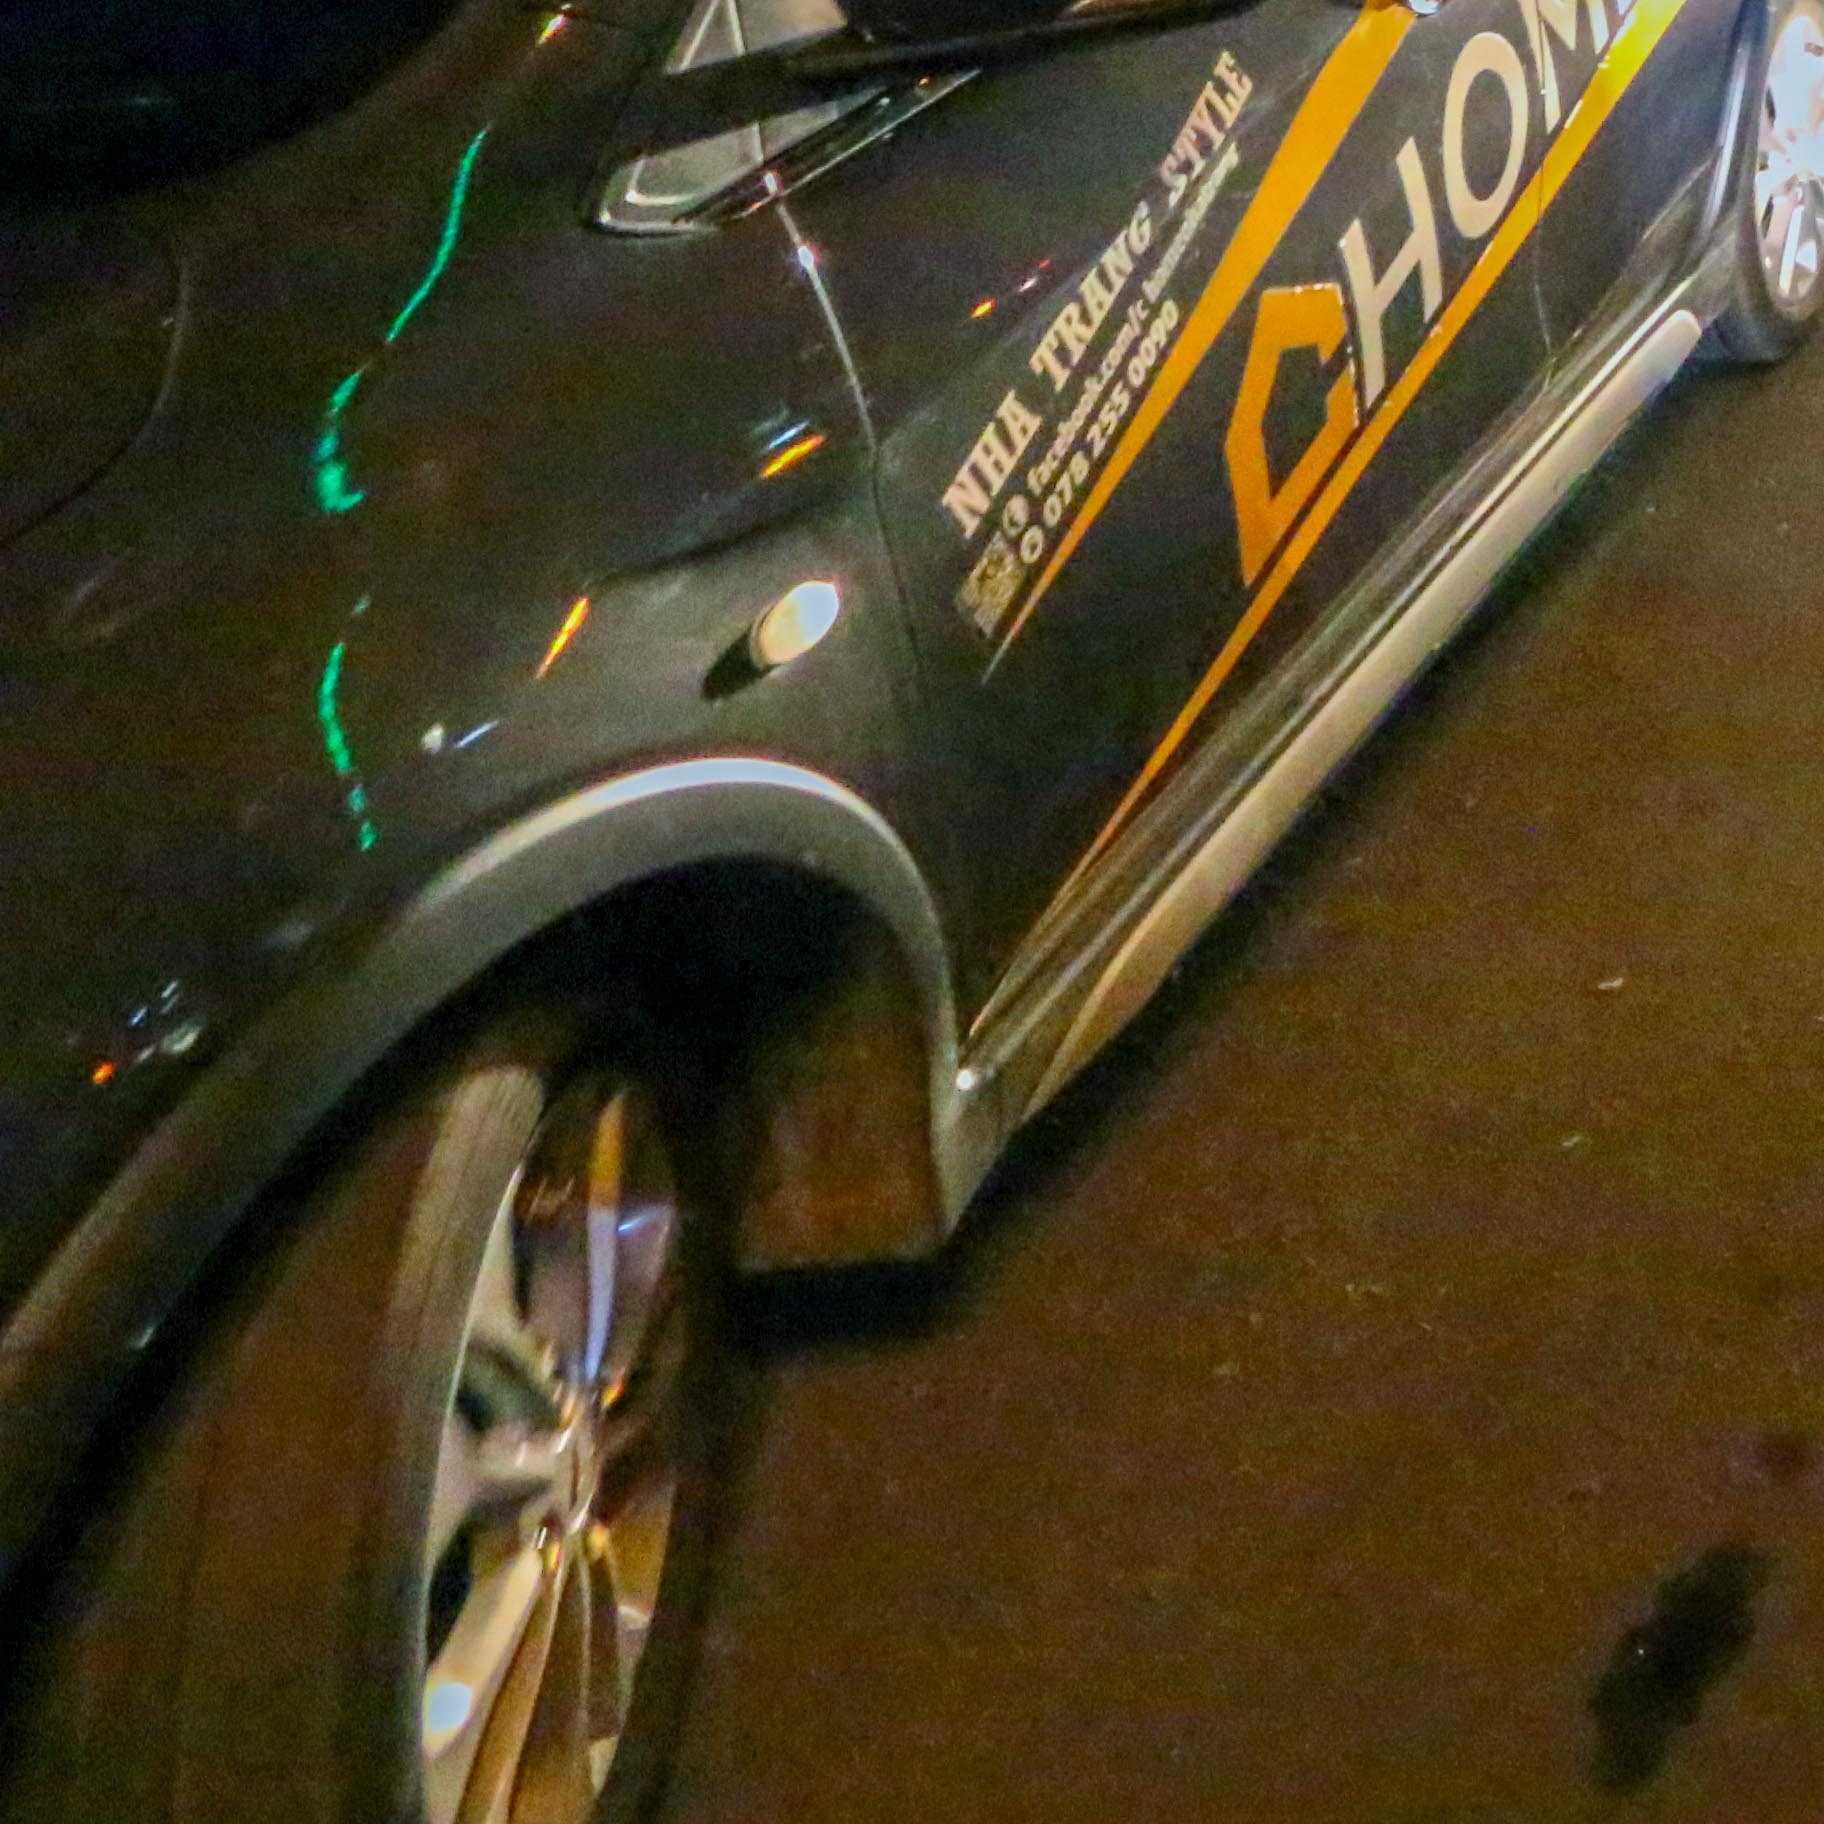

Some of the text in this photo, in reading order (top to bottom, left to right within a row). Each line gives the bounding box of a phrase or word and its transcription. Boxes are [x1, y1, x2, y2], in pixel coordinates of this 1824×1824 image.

[942, 388, 1043, 539] NHA
[1030, 200, 1151, 393] TRANG
[1160, 49, 1253, 207] STYLE
[1043, 450, 1090, 528] 078
[1087, 380, 1131, 458] 255
